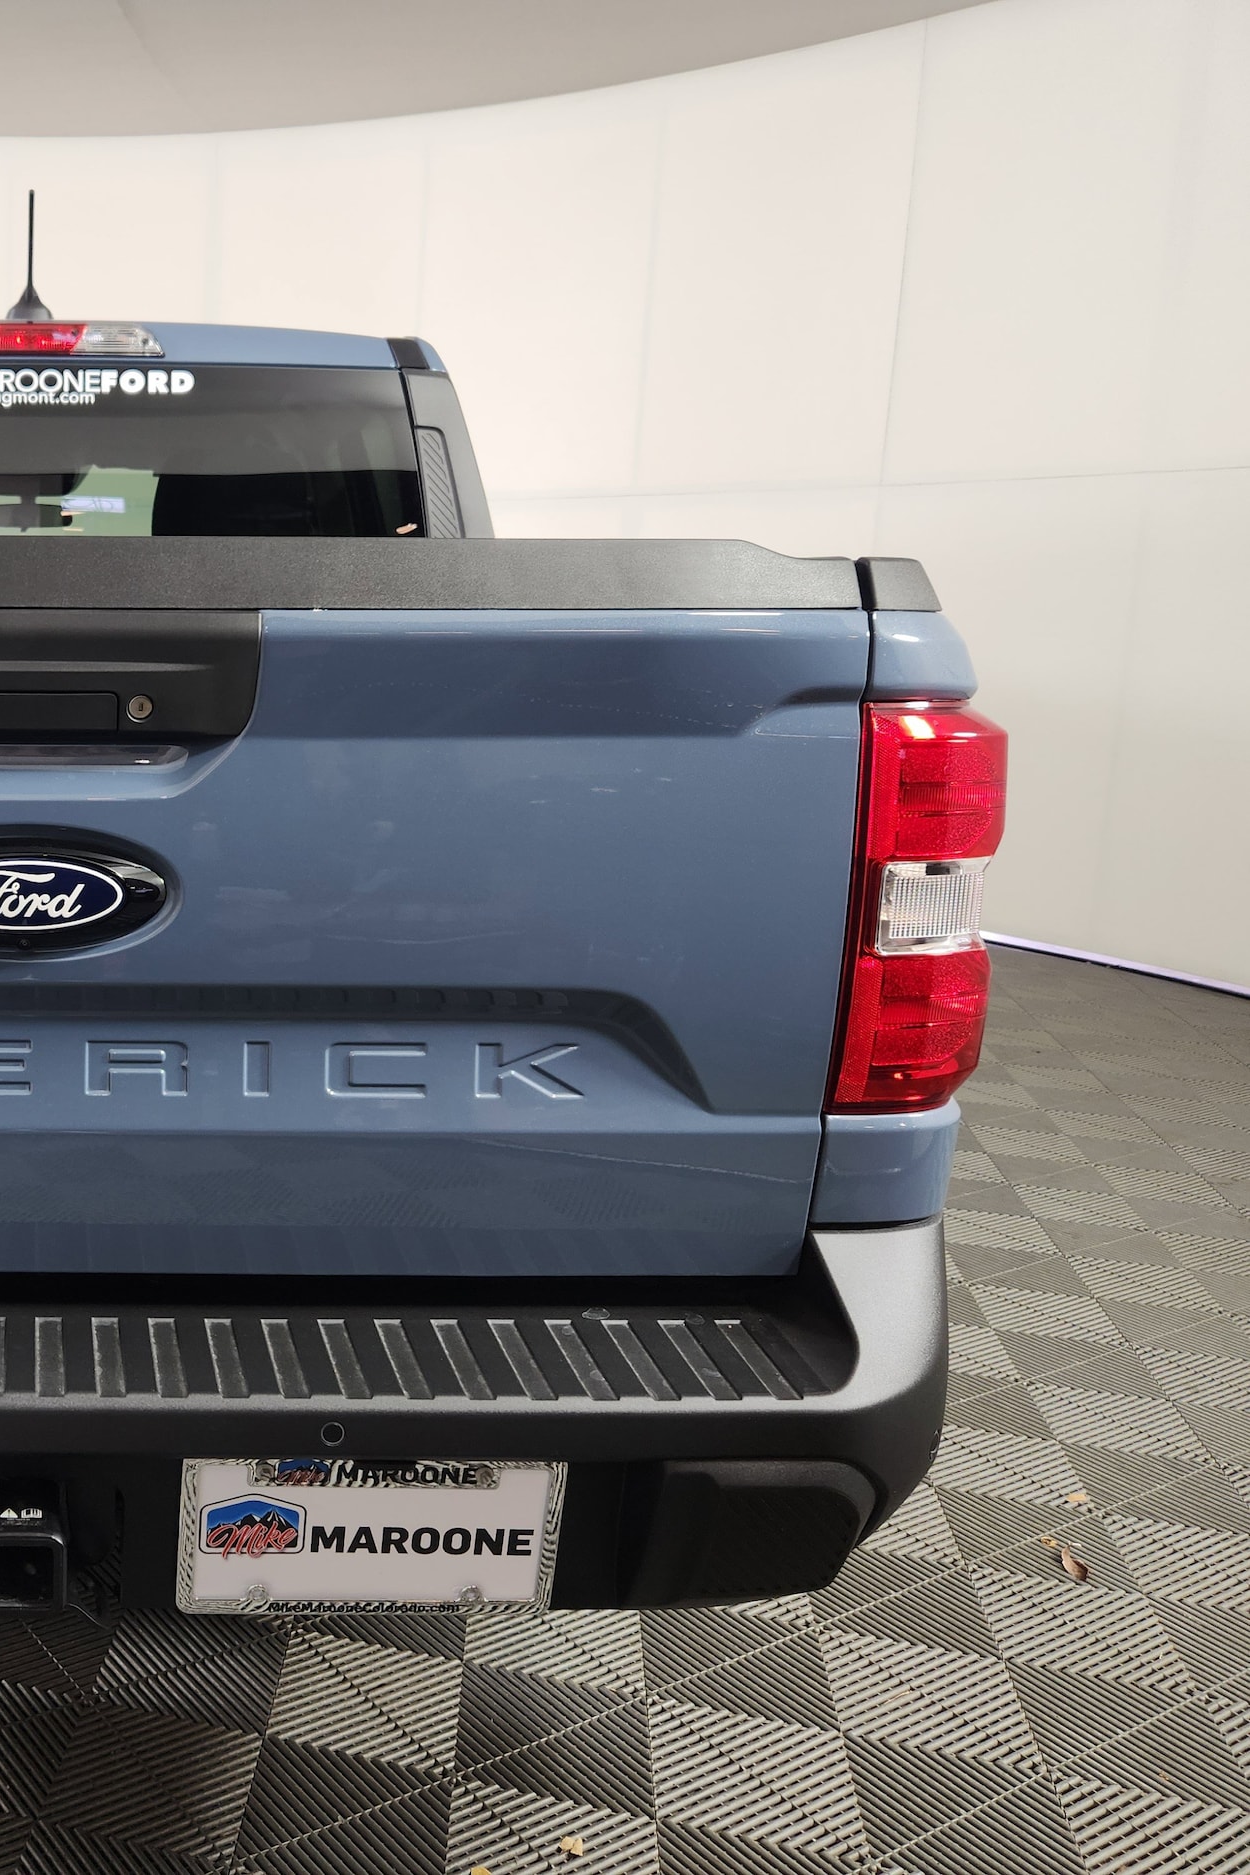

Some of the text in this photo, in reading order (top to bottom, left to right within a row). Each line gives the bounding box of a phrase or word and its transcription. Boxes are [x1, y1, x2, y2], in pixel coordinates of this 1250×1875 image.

[336, 1464, 478, 1485] MAROONE
[206, 1520, 535, 1561] Mike MAROONE
